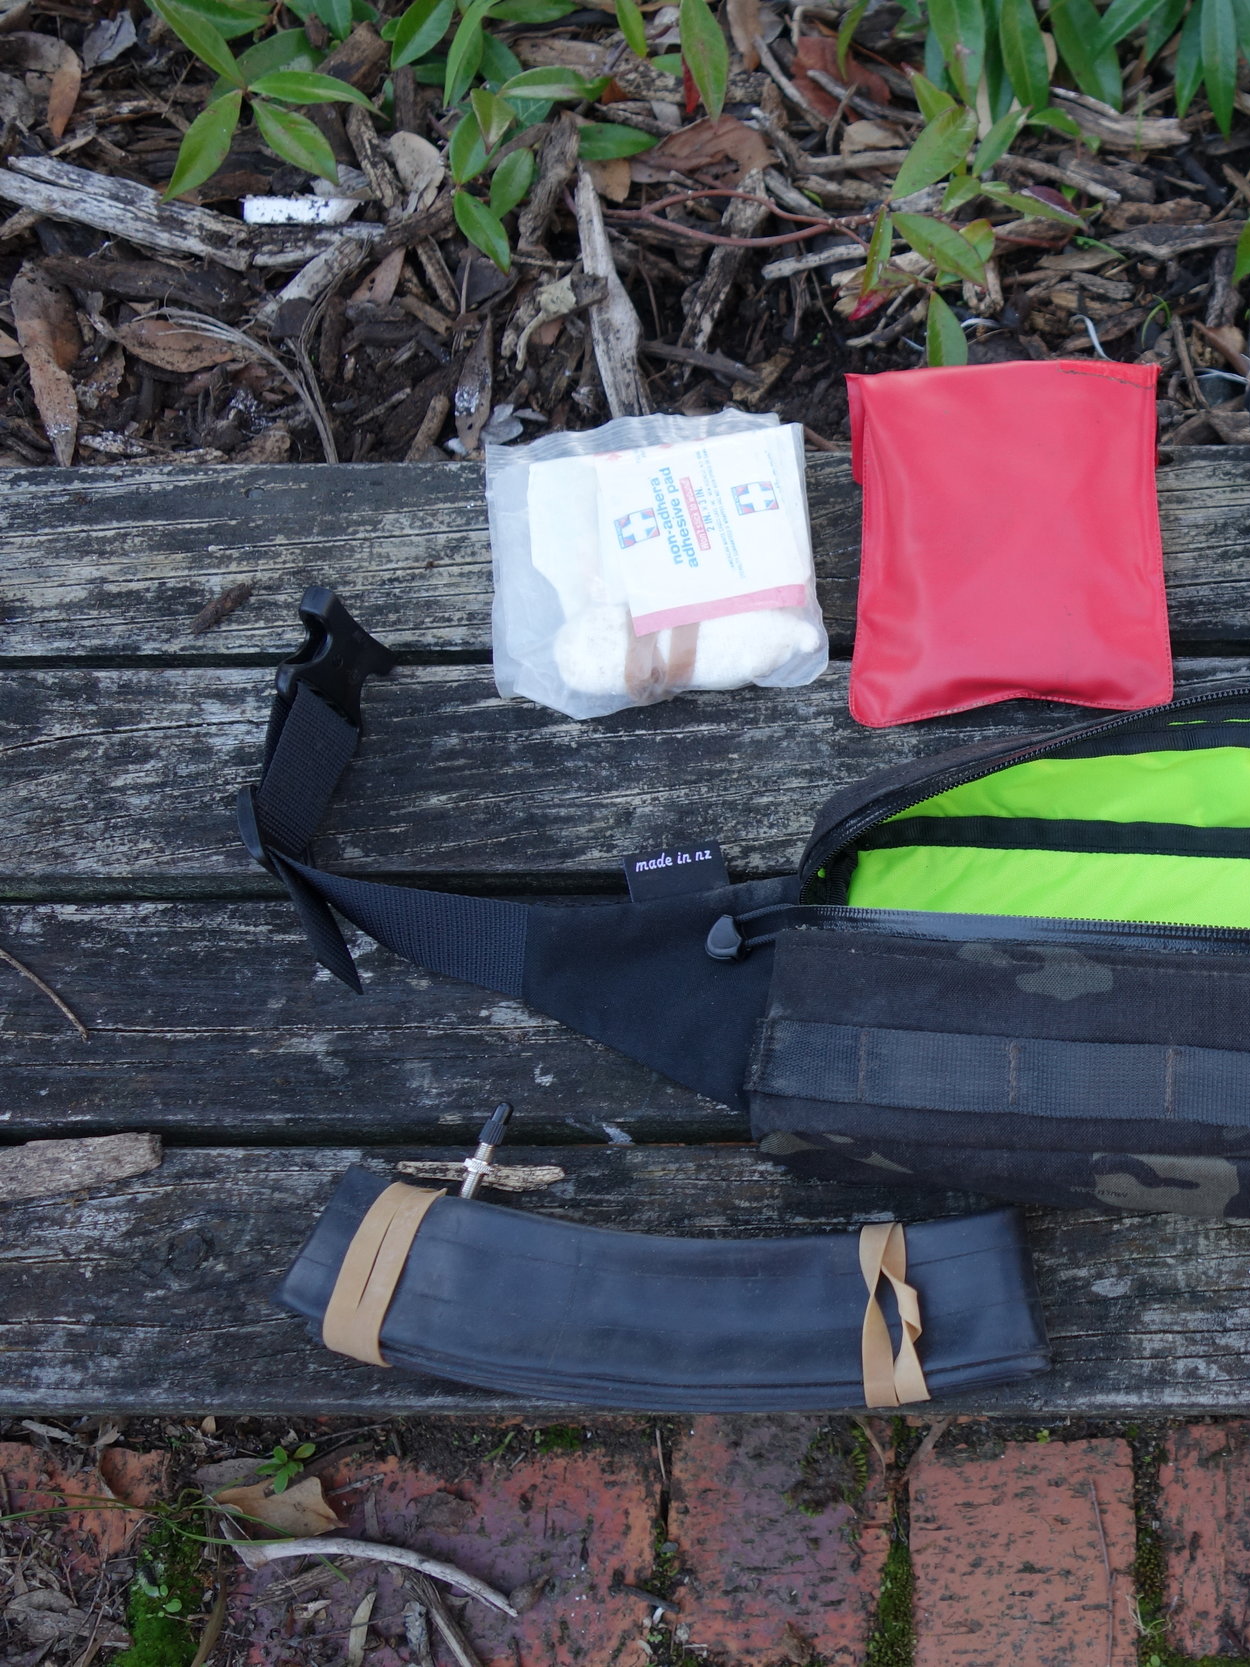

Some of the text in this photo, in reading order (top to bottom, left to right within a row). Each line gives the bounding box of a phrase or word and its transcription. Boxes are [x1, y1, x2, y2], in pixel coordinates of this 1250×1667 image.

[659, 467, 699, 568] adhesive pad
[635, 849, 712, 872] made in nz
